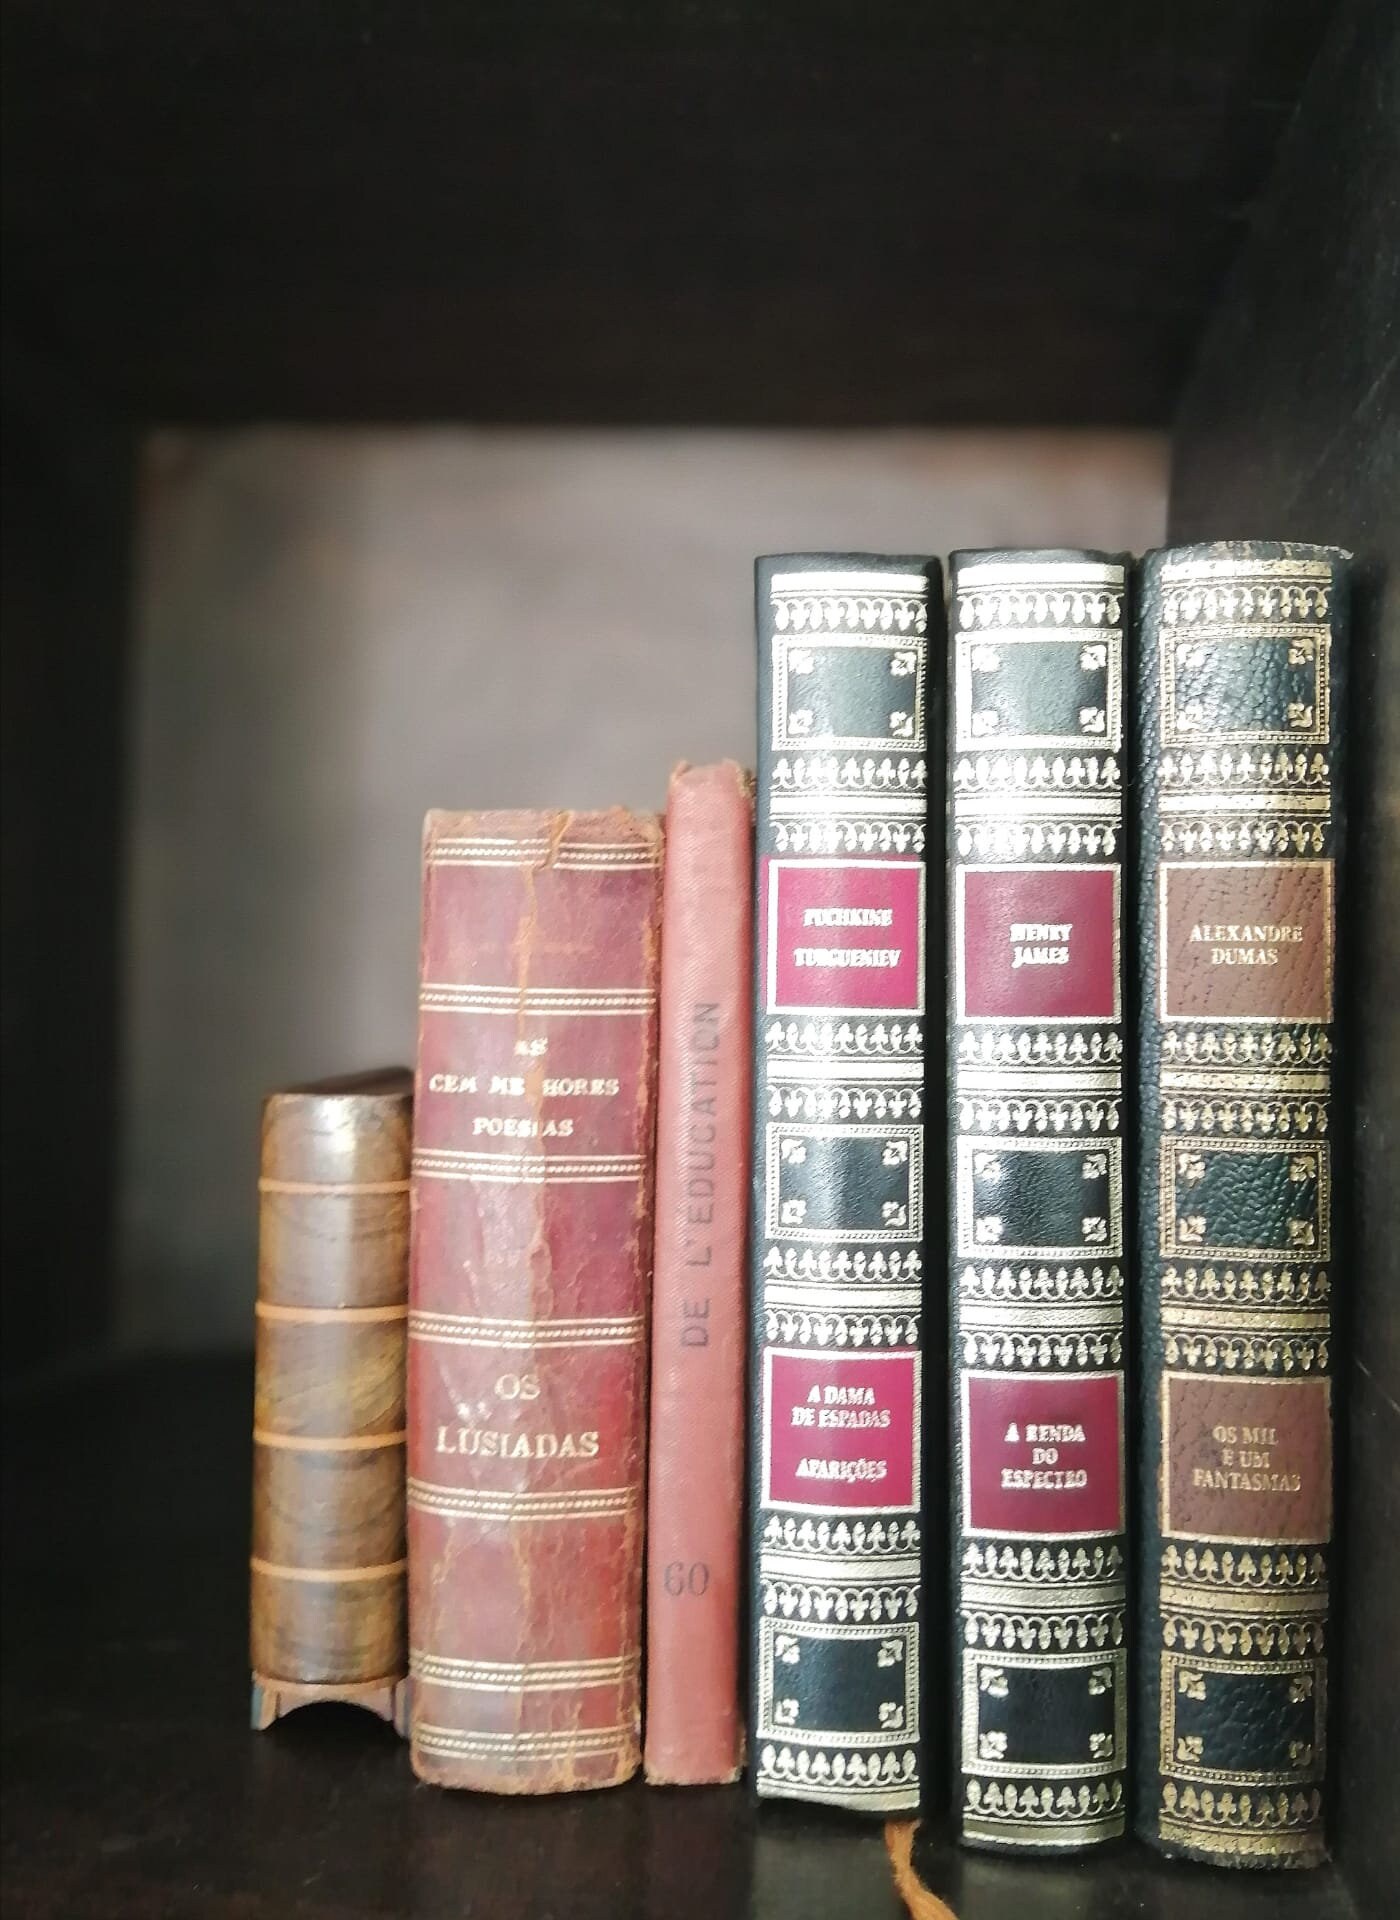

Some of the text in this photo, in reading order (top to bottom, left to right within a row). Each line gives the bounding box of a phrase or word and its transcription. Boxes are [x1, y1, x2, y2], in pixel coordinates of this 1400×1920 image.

[1010, 923, 1073, 942] HENRY
[1190, 924, 1303, 942] ALEXANDRE
[1011, 946, 1070, 968] JAMES
[1211, 948, 1279, 965] DUMAS
[514, 1038, 548, 1057] AS
[429, 1073, 620, 1097] CEM MEHORES
[472, 1116, 574, 1138] POESIAS
[680, 1298, 710, 1348] DE
[494, 1373, 541, 1400] OS
[807, 1384, 876, 1406] A DAMA
[791, 1406, 891, 1429] DE ESPADAS
[434, 1425, 600, 1459] LUSIADAS
[1004, 1422, 1020, 1442] A
[1212, 1425, 1279, 1445] OS MIL
[1032, 1447, 1059, 1465] DO
[1221, 1449, 1271, 1468] E UM
[795, 1457, 888, 1483] APARIÇÕES
[1001, 1468, 1088, 1489] ESPECTRO
[1192, 1468, 1302, 1492] FANTASMAS
[664, 1560, 710, 1597] 60
